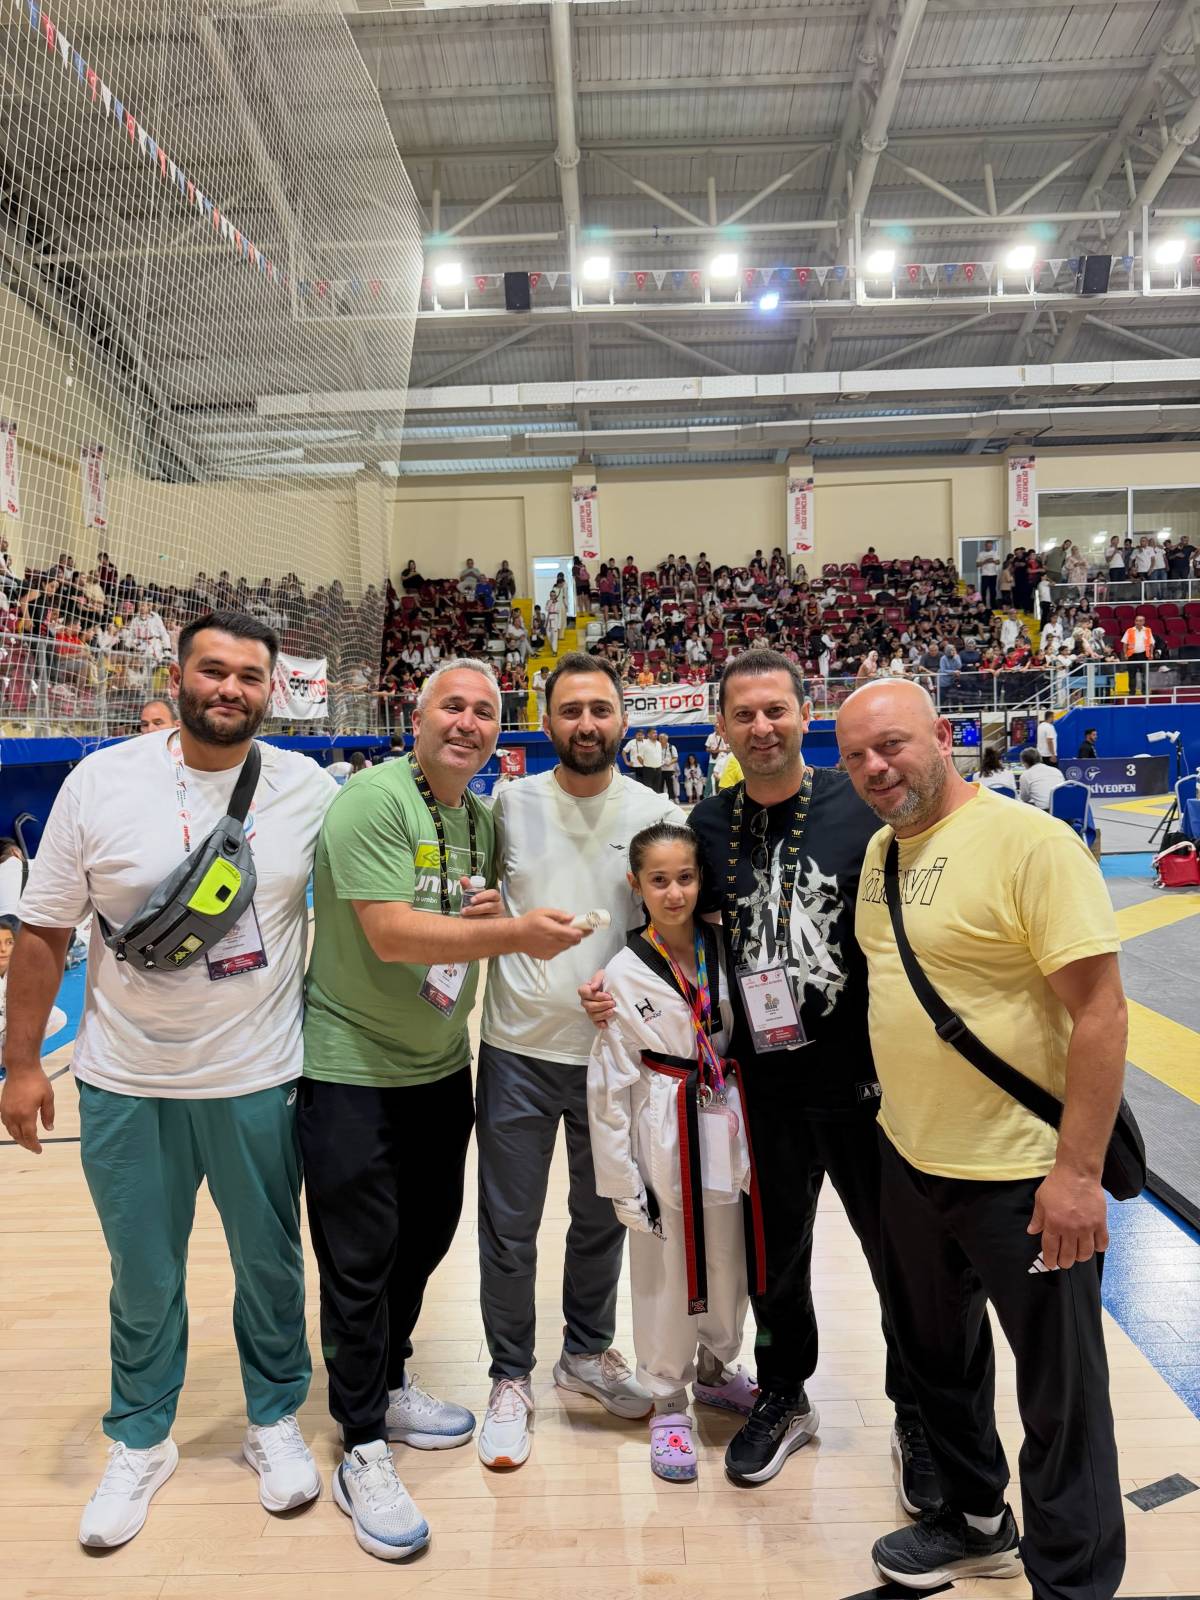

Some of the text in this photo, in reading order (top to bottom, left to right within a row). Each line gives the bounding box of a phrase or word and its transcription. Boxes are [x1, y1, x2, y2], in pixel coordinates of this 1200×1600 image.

[623, 694, 704, 711] PORTOTO
[1126, 763, 1136, 777] 3
[1089, 783, 1137, 794] KİYEOPEN
